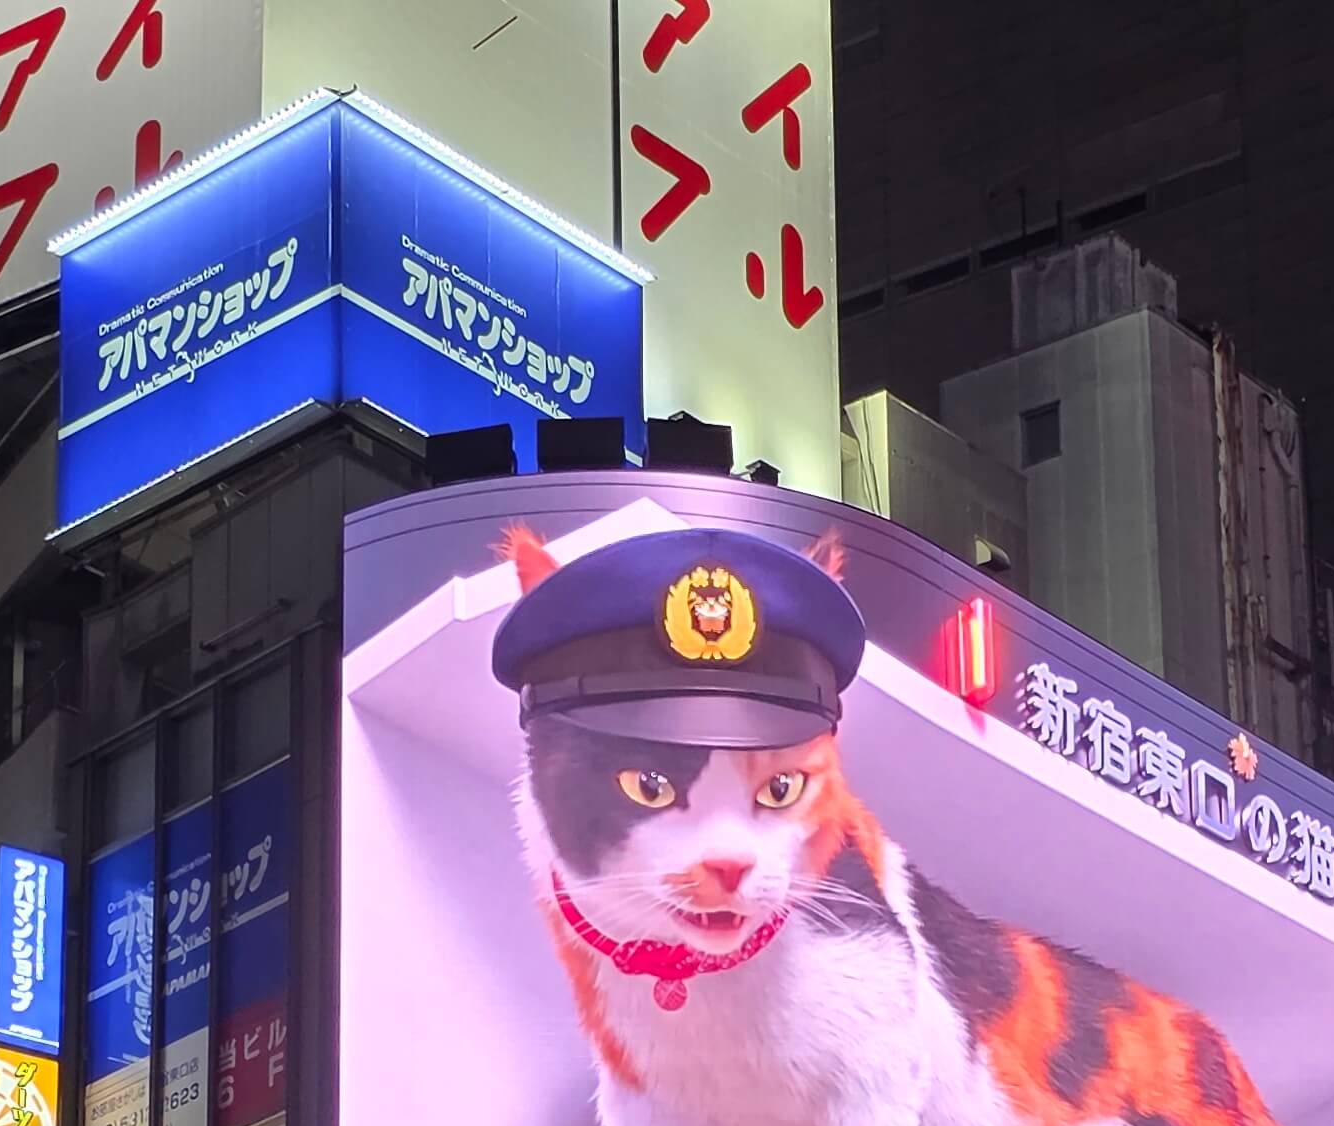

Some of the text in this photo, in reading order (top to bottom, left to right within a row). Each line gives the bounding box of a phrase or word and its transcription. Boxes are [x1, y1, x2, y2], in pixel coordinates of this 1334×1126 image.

[98, 236, 299, 392] アパマンショップ
[98, 304, 145, 337] Dramatic
[401, 234, 528, 319] Dramatic Communication
[402, 257, 595, 404] アパマンショップ
[11, 858, 37, 1013] アパマンショップ
